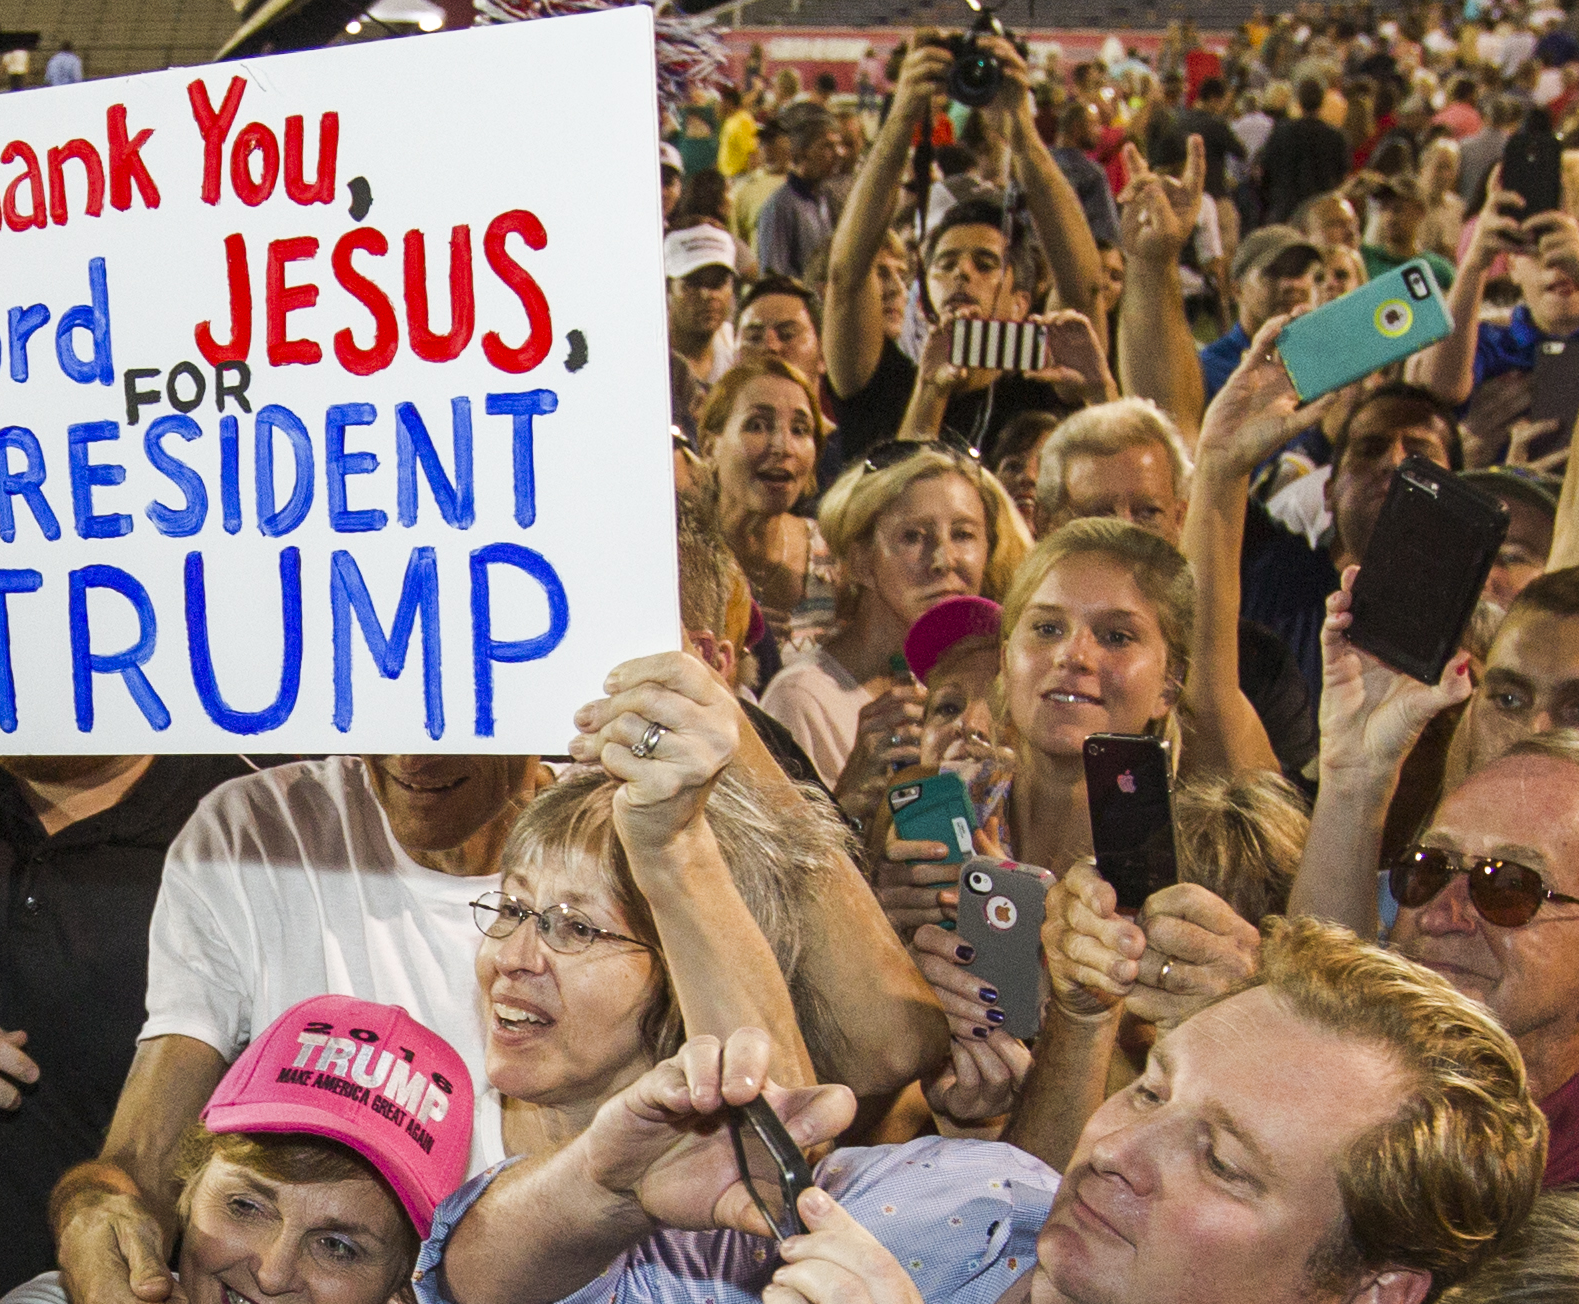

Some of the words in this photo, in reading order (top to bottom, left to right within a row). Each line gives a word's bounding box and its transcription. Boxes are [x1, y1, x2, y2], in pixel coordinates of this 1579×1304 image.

[187, 75, 373, 220] You,
[195, 209, 588, 376] JESUS,
[124, 361, 252, 425] FOR
[292, 1031, 450, 1125] TRUMP
[303, 1021, 454, 1095] 2016
[275, 1067, 314, 1087] MAKE
[311, 1073, 371, 1106] AMERICA
[371, 1094, 408, 1128] GREAT
[405, 1118, 436, 1156] AGAIN
